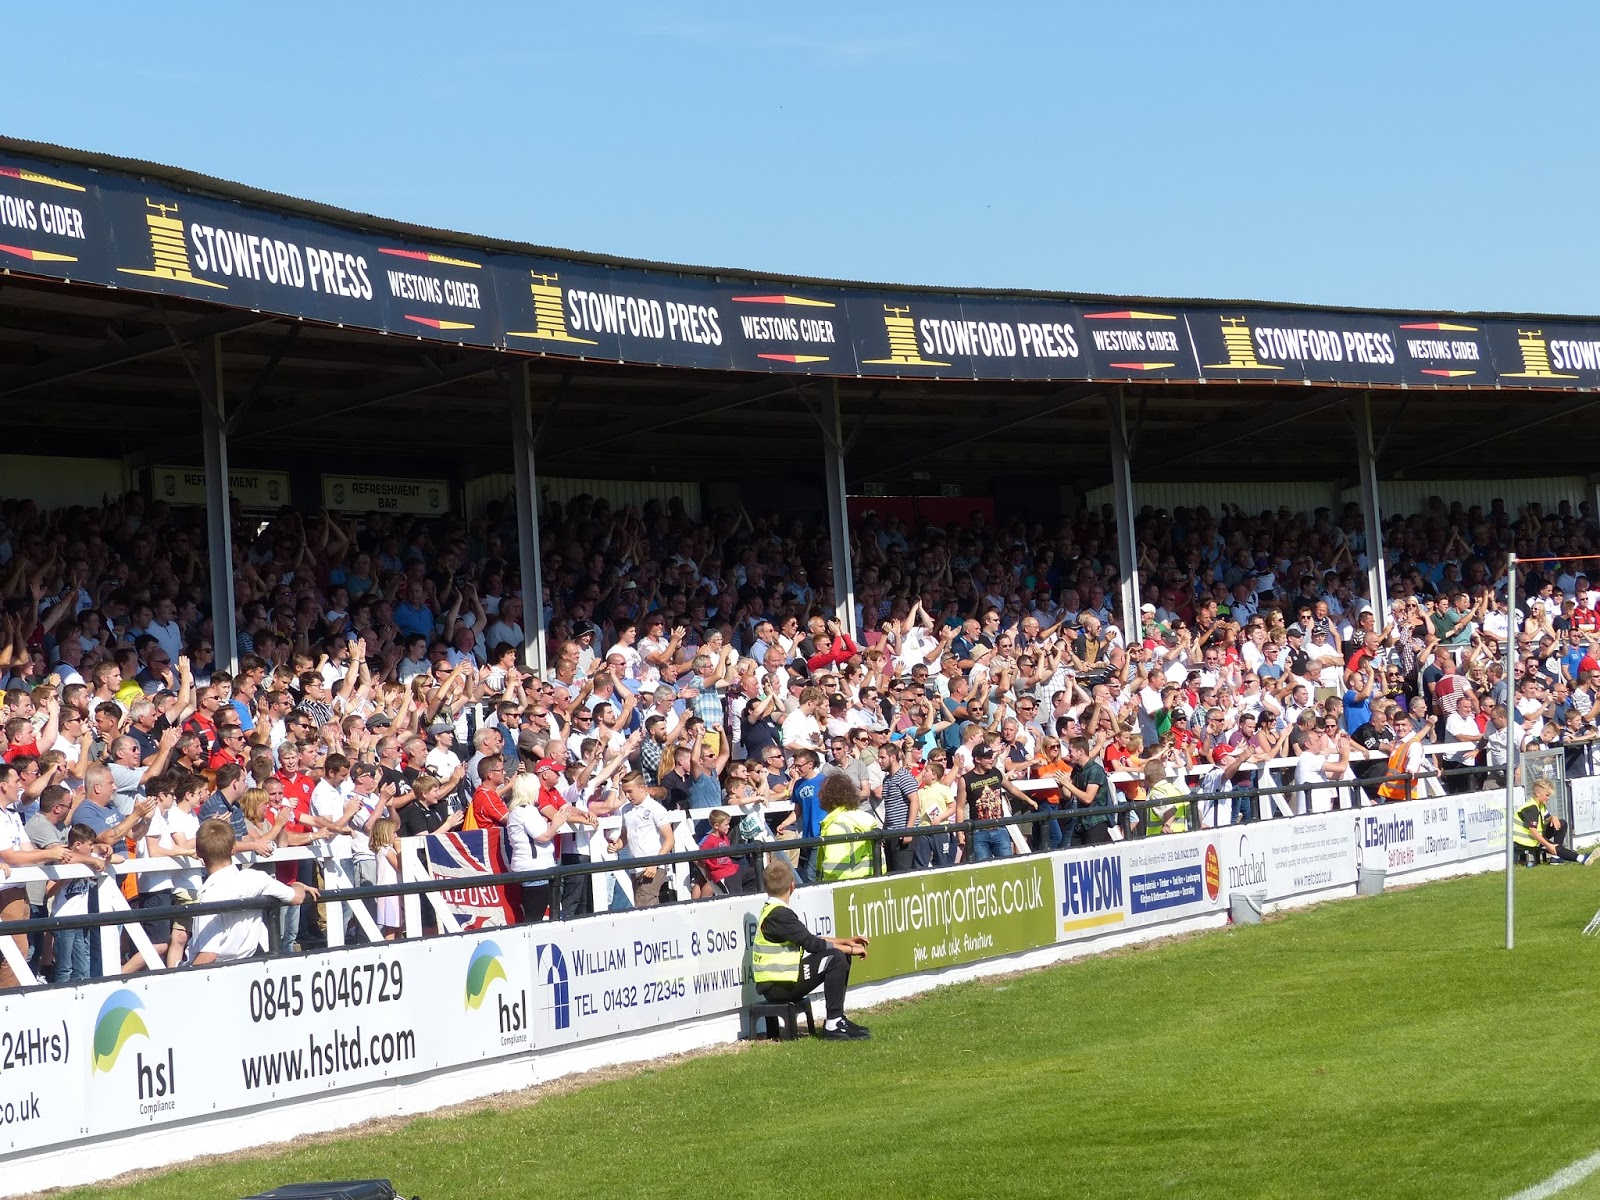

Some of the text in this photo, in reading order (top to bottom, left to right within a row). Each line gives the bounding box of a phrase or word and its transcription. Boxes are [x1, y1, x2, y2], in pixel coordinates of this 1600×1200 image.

[0, 194, 86, 239] TONS CIDER
[191, 223, 373, 301] STOWFORD PRESS
[387, 270, 481, 310] WESTONS CIDER
[568, 289, 723, 346] STOWFORD PRESS
[741, 315, 836, 343] WESTONS CIDER
[920, 319, 1079, 358] STOWFORD PRESS
[1093, 330, 1179, 352] WESTONS CIDER
[1254, 327, 1395, 364] STOWFORD PRESS
[1407, 339, 1479, 360] WESTONS CIDER
[184, 473, 258, 489] REFMENT
[352, 482, 421, 497] REFRESHMENT
[378, 497, 398, 509] BAR
[1062, 855, 1123, 917] JEWSON
[1228, 852, 1267, 888] metclad
[848, 867, 1043, 938] furnitureimporters.co.uk
[814, 916, 832, 936] LTD
[572, 946, 627, 976] WILLIAM
[634, 938, 684, 967] POWELL
[691, 931, 701, 956] &
[706, 928, 737, 954] SONS
[249, 960, 403, 1023] 0845 6046729
[574, 964, 756, 1017] TEL 01432 272345 WWW.WILLIA
[498, 990, 527, 1033] hsl
[0, 1019, 69, 1075] 24Hrs)
[241, 1026, 416, 1090] www.hsltd.com
[501, 1034, 527, 1046] Compliance
[137, 1048, 176, 1100] hsl
[139, 1100, 176, 1115] Compliance
